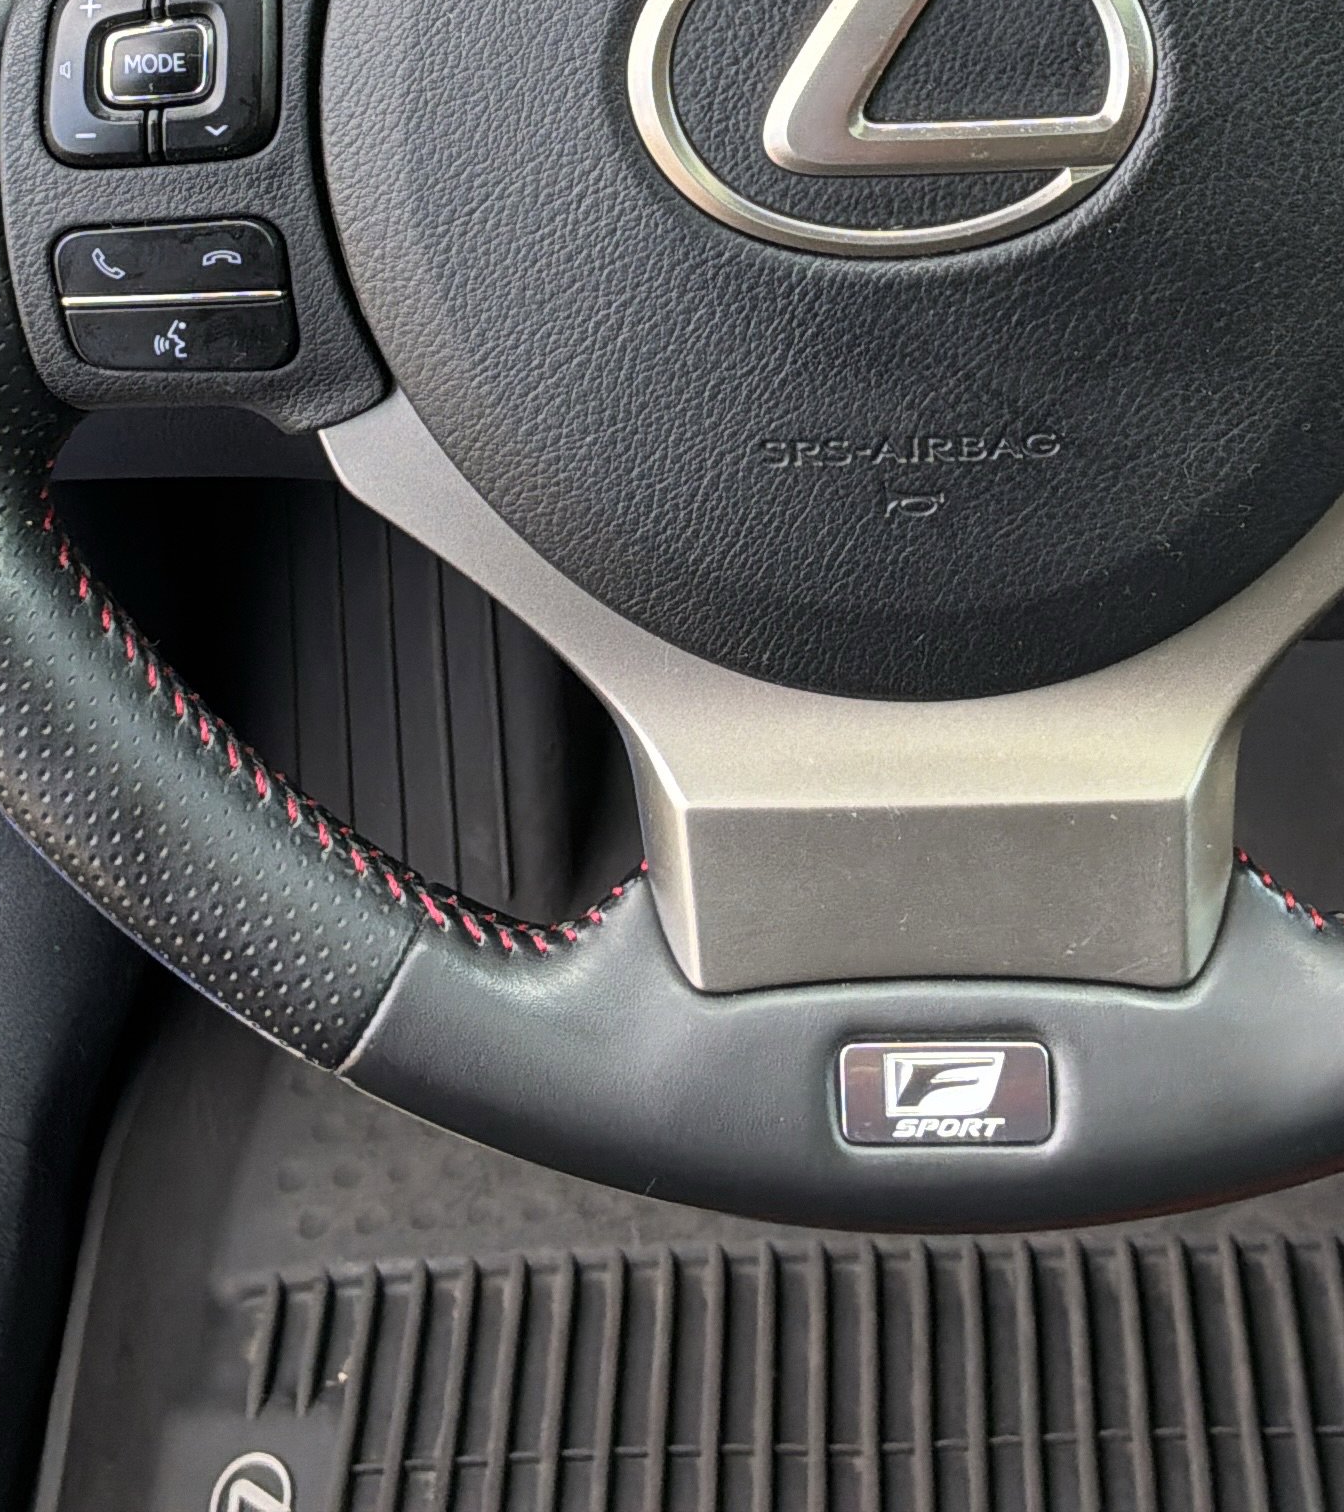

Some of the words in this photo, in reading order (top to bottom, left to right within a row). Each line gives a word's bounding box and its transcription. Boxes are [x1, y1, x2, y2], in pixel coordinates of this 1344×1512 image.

[124, 53, 187, 74] MODE
[762, 434, 1062, 468] SRS-AIRBAG
[892, 1118, 1005, 1138] SPORT
